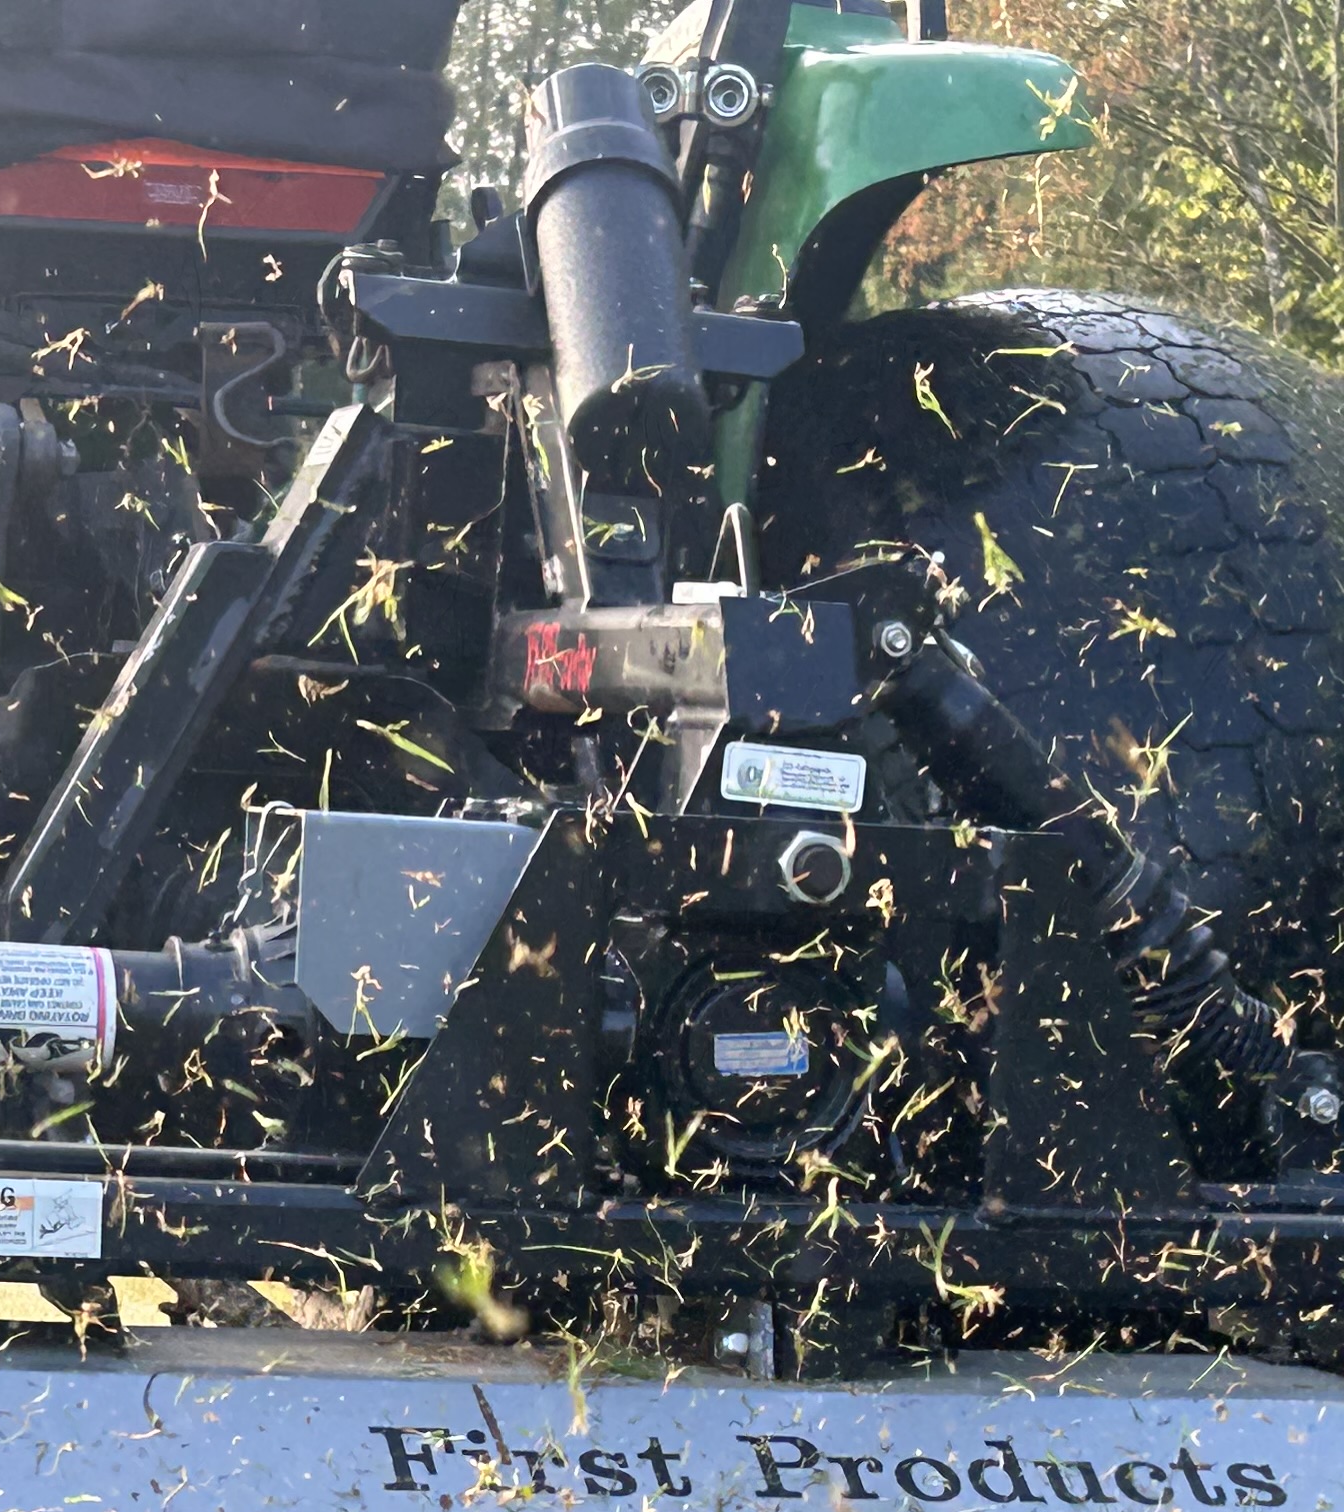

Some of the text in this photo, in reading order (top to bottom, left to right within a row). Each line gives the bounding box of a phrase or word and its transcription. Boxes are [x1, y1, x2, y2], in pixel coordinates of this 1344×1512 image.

[29, 988, 63, 999] KEEP
[368, 1426, 1287, 1507] First Products
